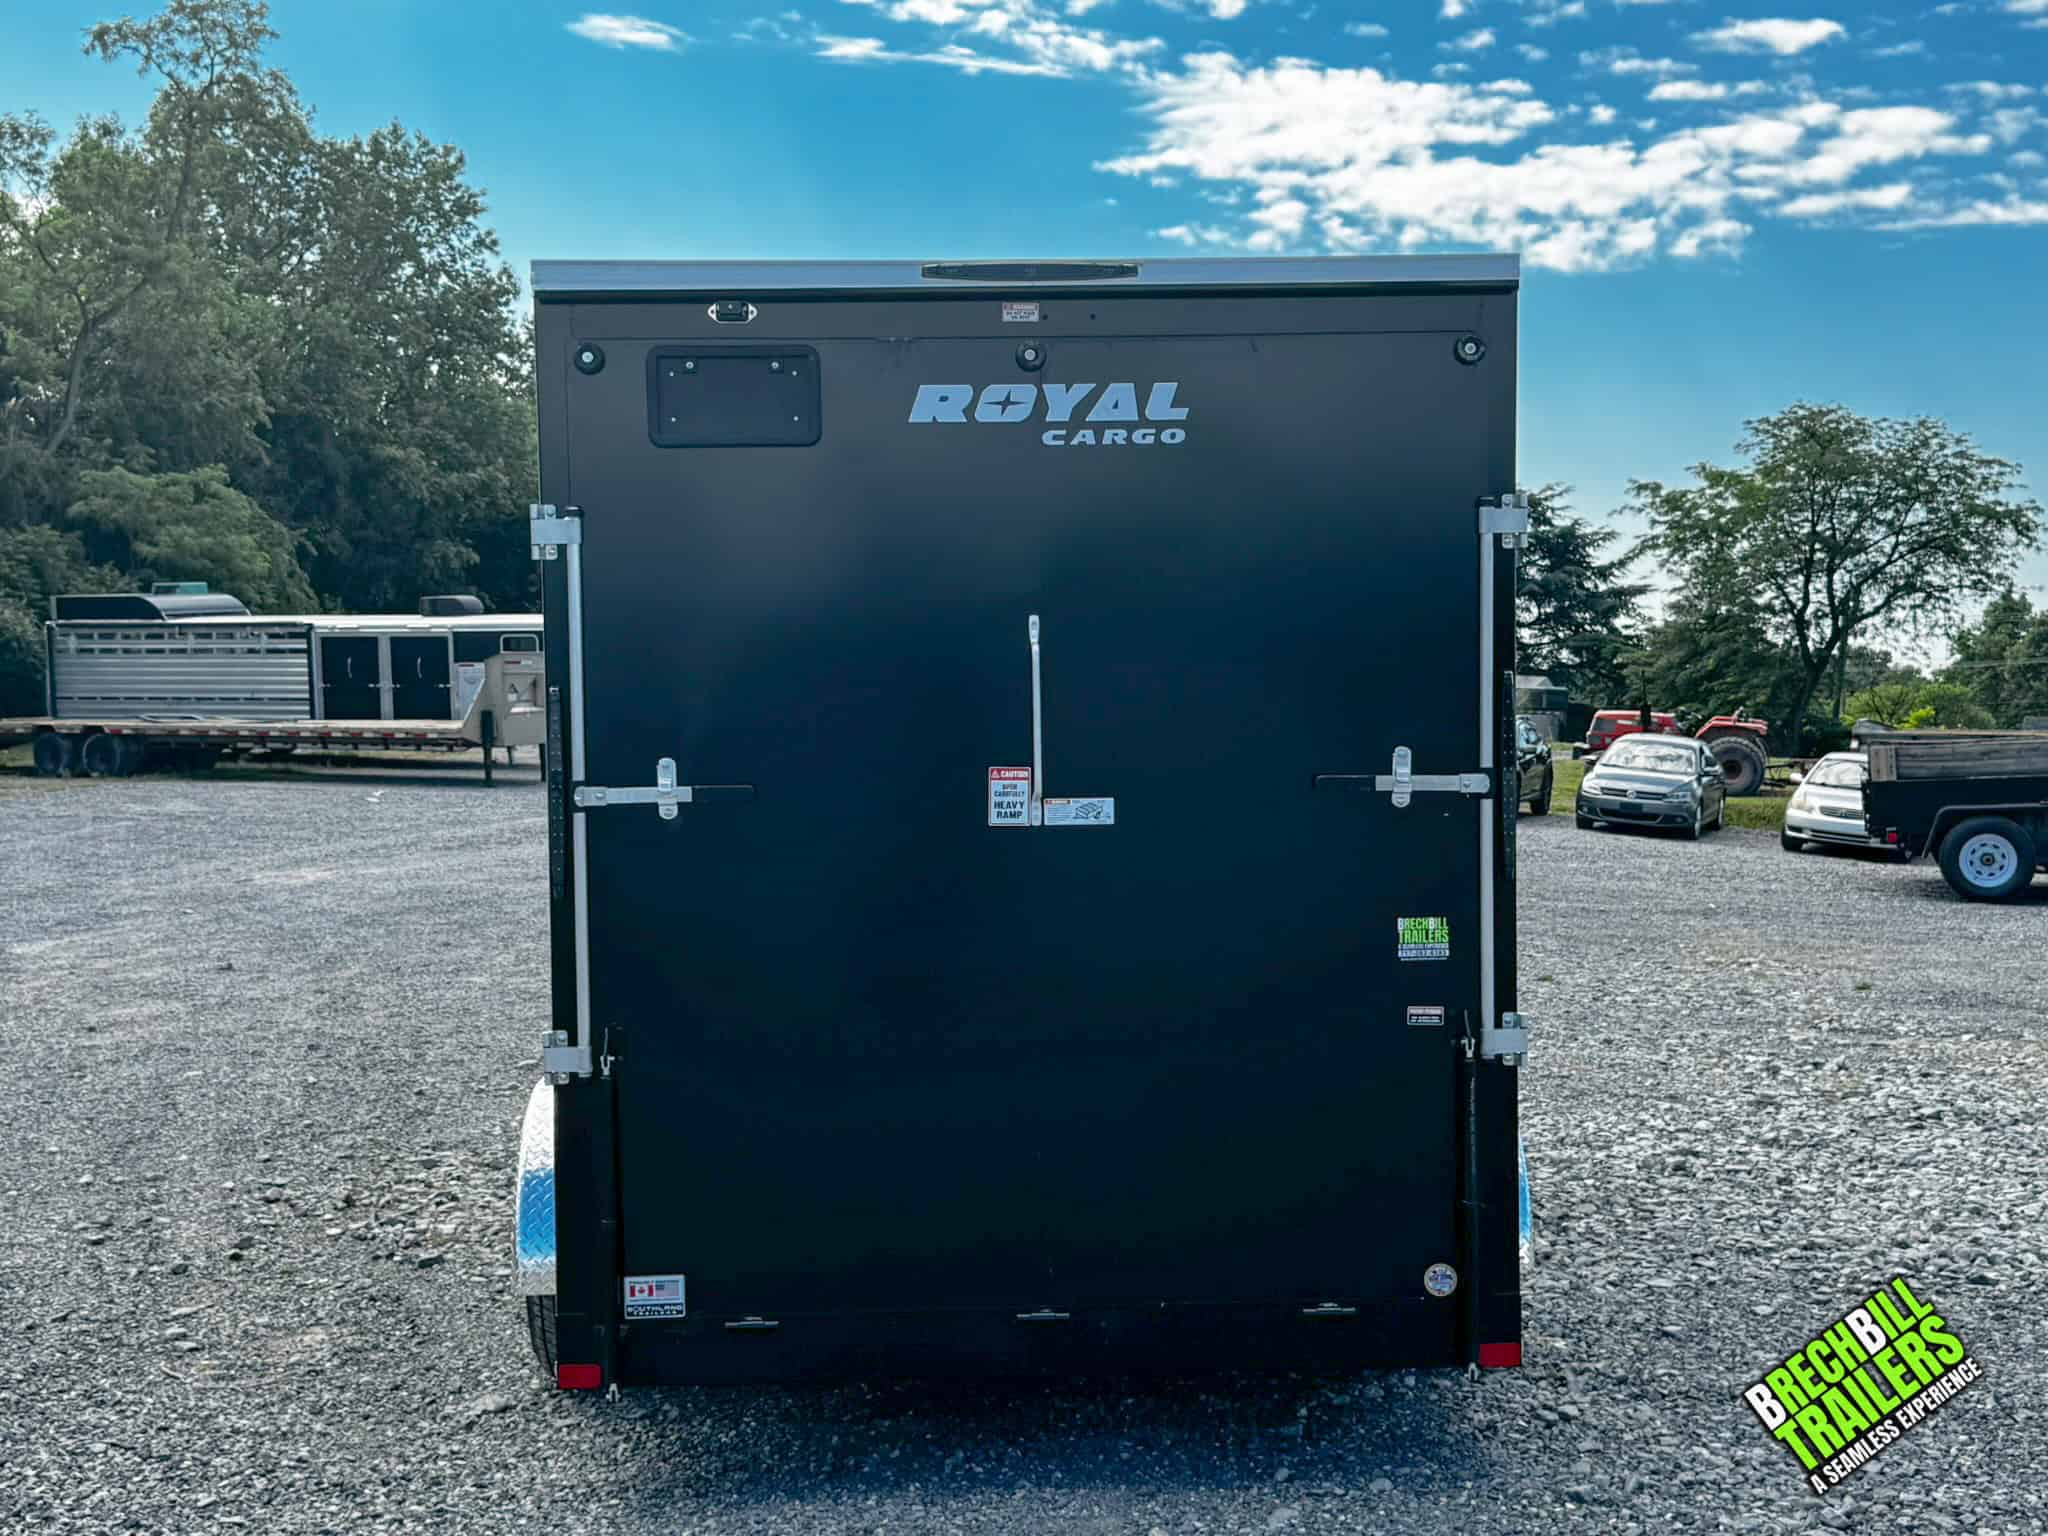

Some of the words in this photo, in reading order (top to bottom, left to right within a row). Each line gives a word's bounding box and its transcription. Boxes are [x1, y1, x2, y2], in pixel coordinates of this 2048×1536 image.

[908, 382, 1190, 423] ROYAL
[1042, 428, 1186, 446] CARGO
[994, 800, 1025, 810] HEAVY
[996, 810, 1023, 820] RAMP
[1397, 917, 1449, 930] BRECHBILL
[1399, 930, 1449, 944] TRAILERS
